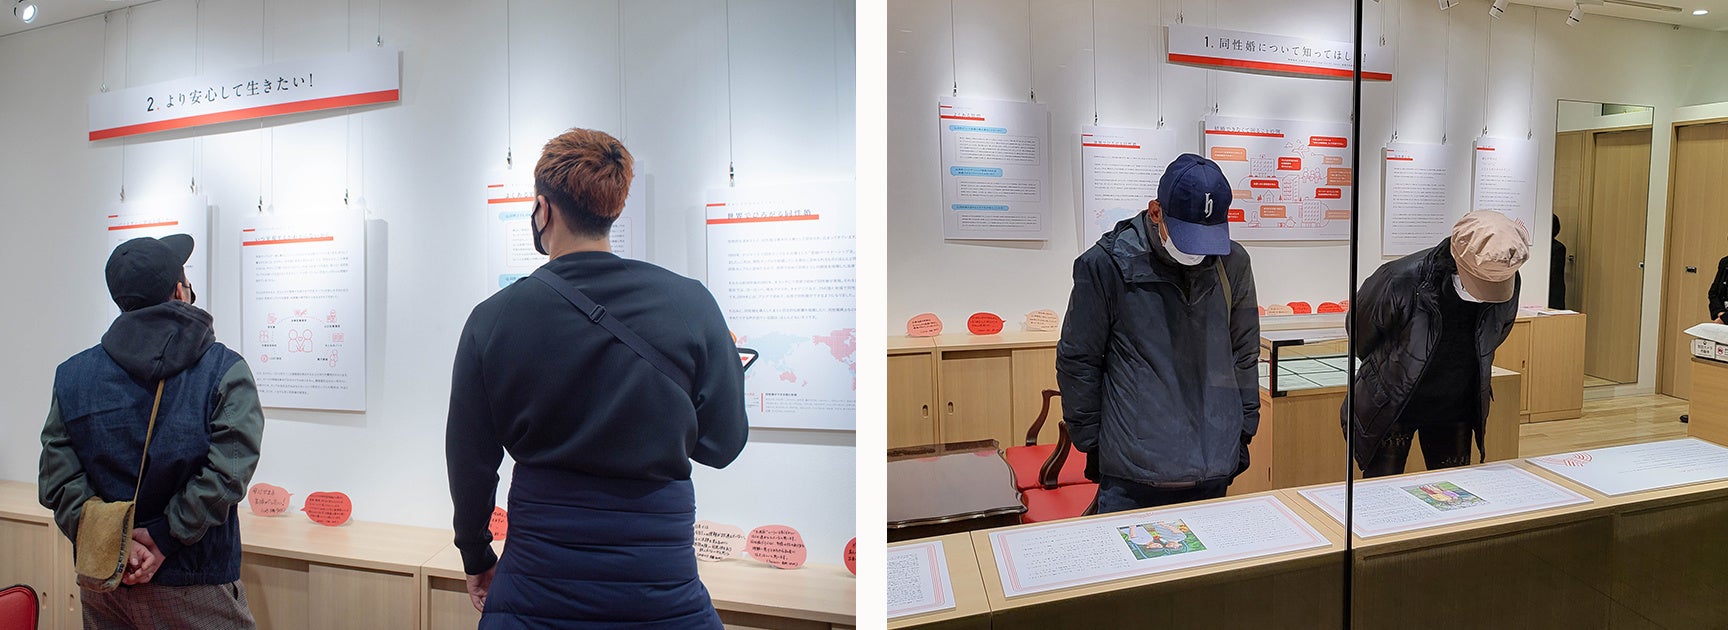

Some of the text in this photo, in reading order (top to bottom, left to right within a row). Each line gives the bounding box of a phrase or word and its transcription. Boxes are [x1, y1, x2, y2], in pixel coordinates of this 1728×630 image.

[1219, 37, 1367, 63] 同性婚について知ってほし!
[166, 73, 313, 109] より安心して生きたい!
[727, 209, 812, 219] 世界でひろがる同性婚
